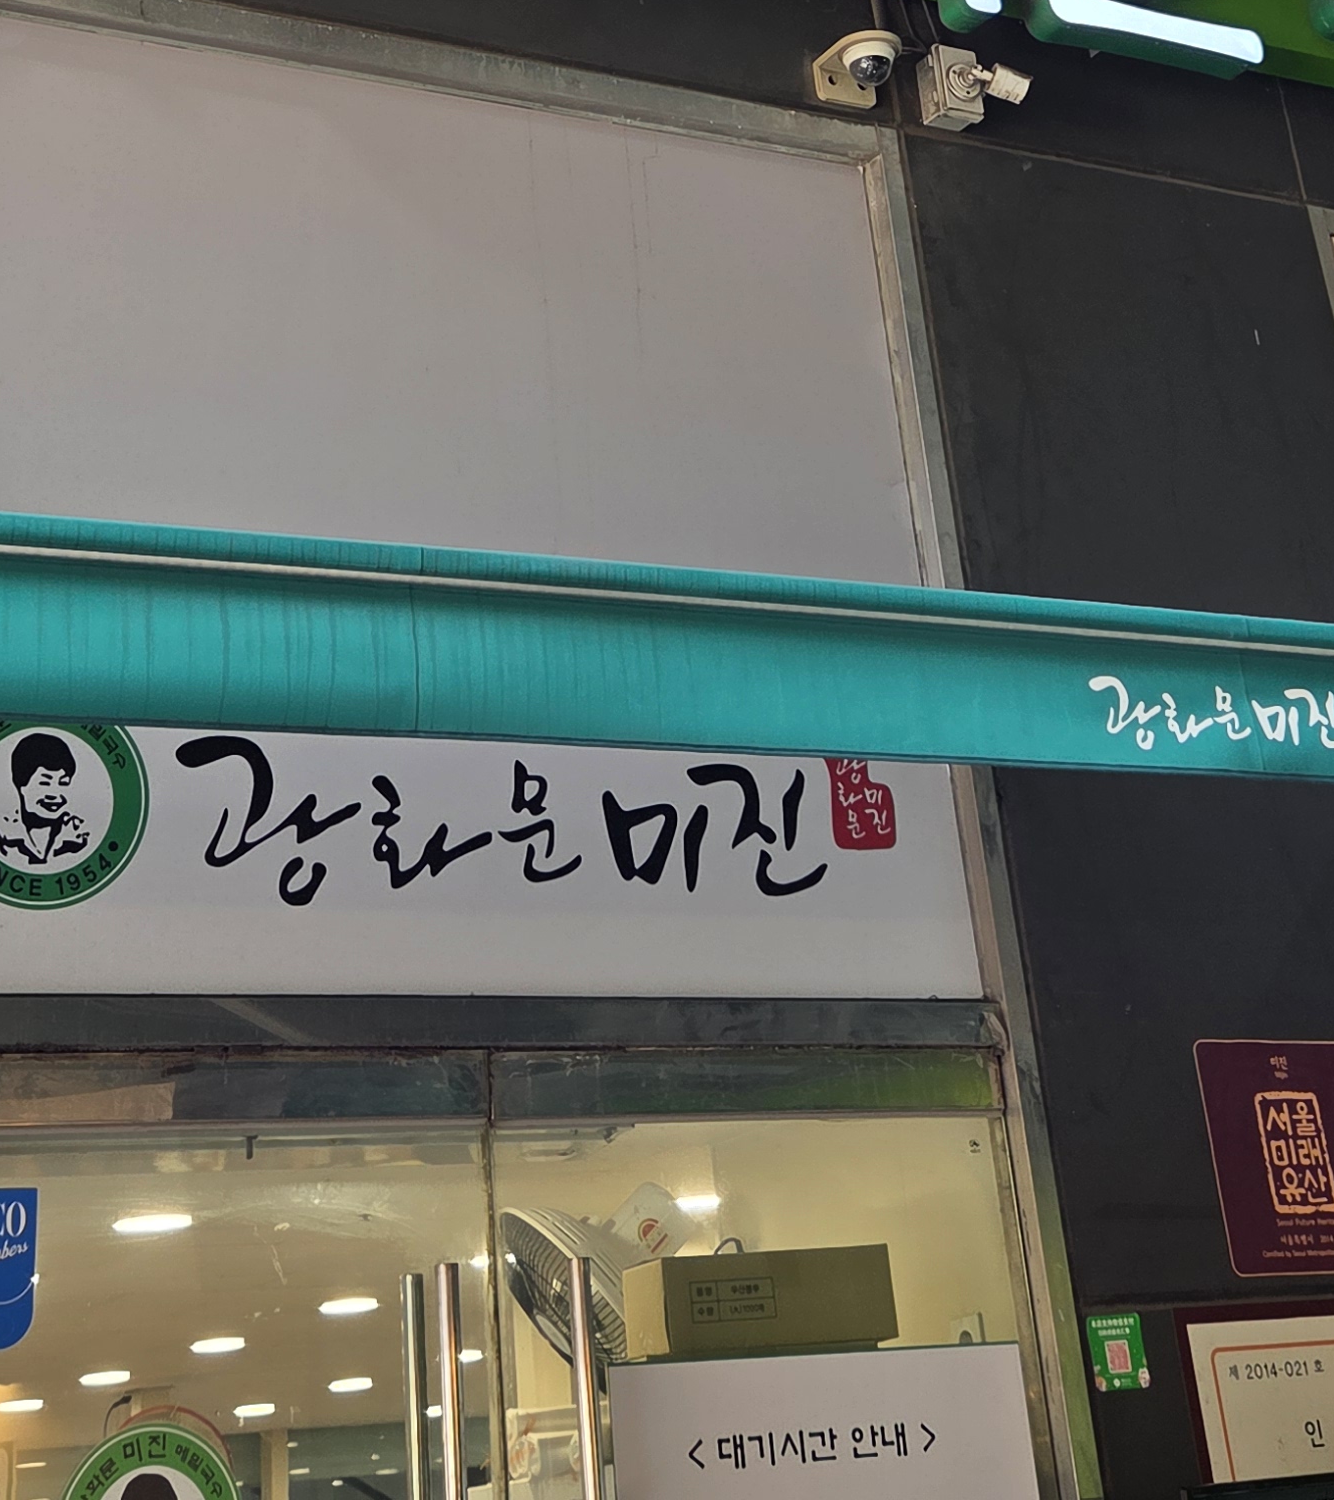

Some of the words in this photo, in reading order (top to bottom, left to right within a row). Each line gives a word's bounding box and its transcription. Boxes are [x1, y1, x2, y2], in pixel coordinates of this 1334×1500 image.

[55, 853, 112, 896] 1954
[1266, 1101, 1318, 1136] 서울
[1270, 1137, 1324, 1166] 미래
[1279, 1167, 1329, 1204] 유산
[1245, 1359, 1309, 1380] 2014-021
[122, 1432, 167, 1463] 미진
[717, 1427, 838, 1469] 대기시간
[851, 1421, 909, 1459] 안내
